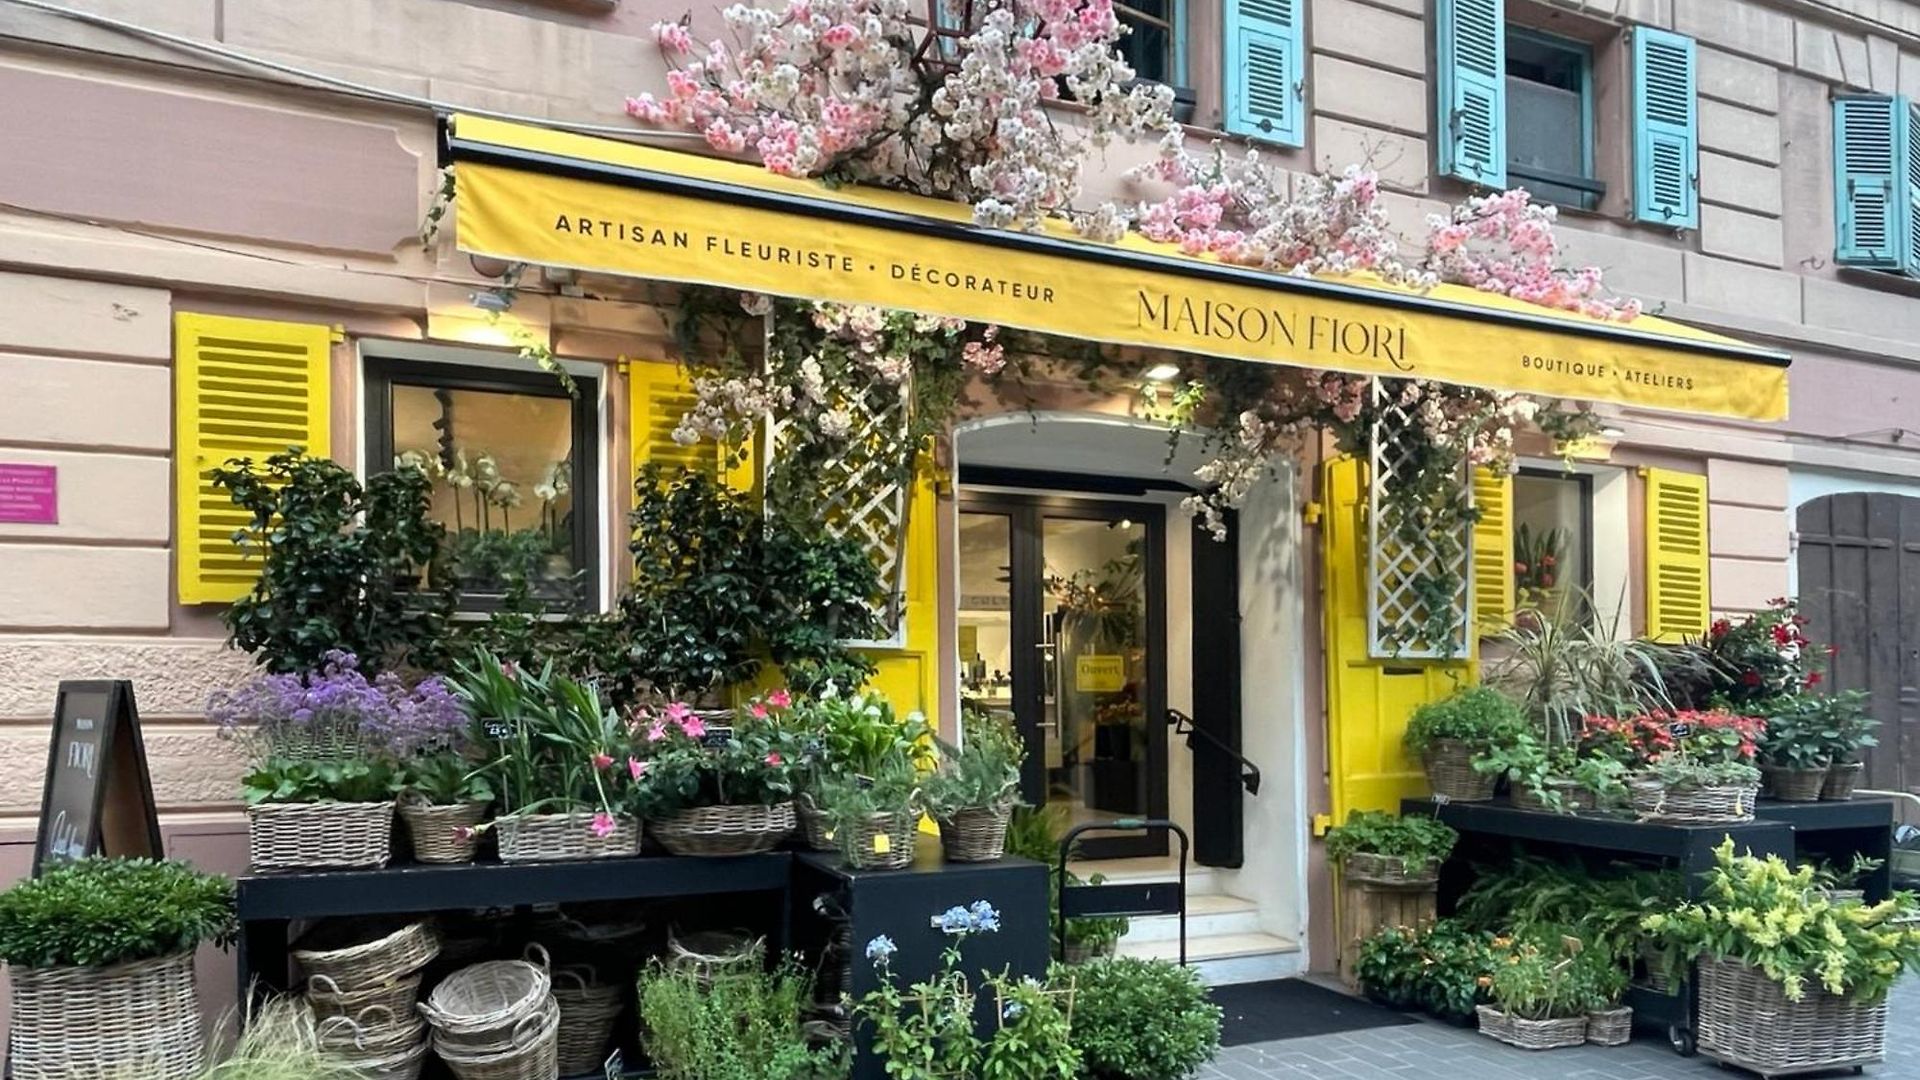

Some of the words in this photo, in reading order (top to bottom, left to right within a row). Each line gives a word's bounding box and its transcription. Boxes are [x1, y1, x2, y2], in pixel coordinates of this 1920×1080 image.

[555, 214, 689, 248] ARTISAN
[706, 236, 854, 272] FLEURISTE
[891, 263, 1055, 303] DÉCORATEUR
[1137, 290, 1297, 346] MAISON
[1308, 315, 1415, 372] FIORI
[1522, 355, 1605, 378] BOUTIQUE
[1625, 369, 1694, 391] ATELIERS
